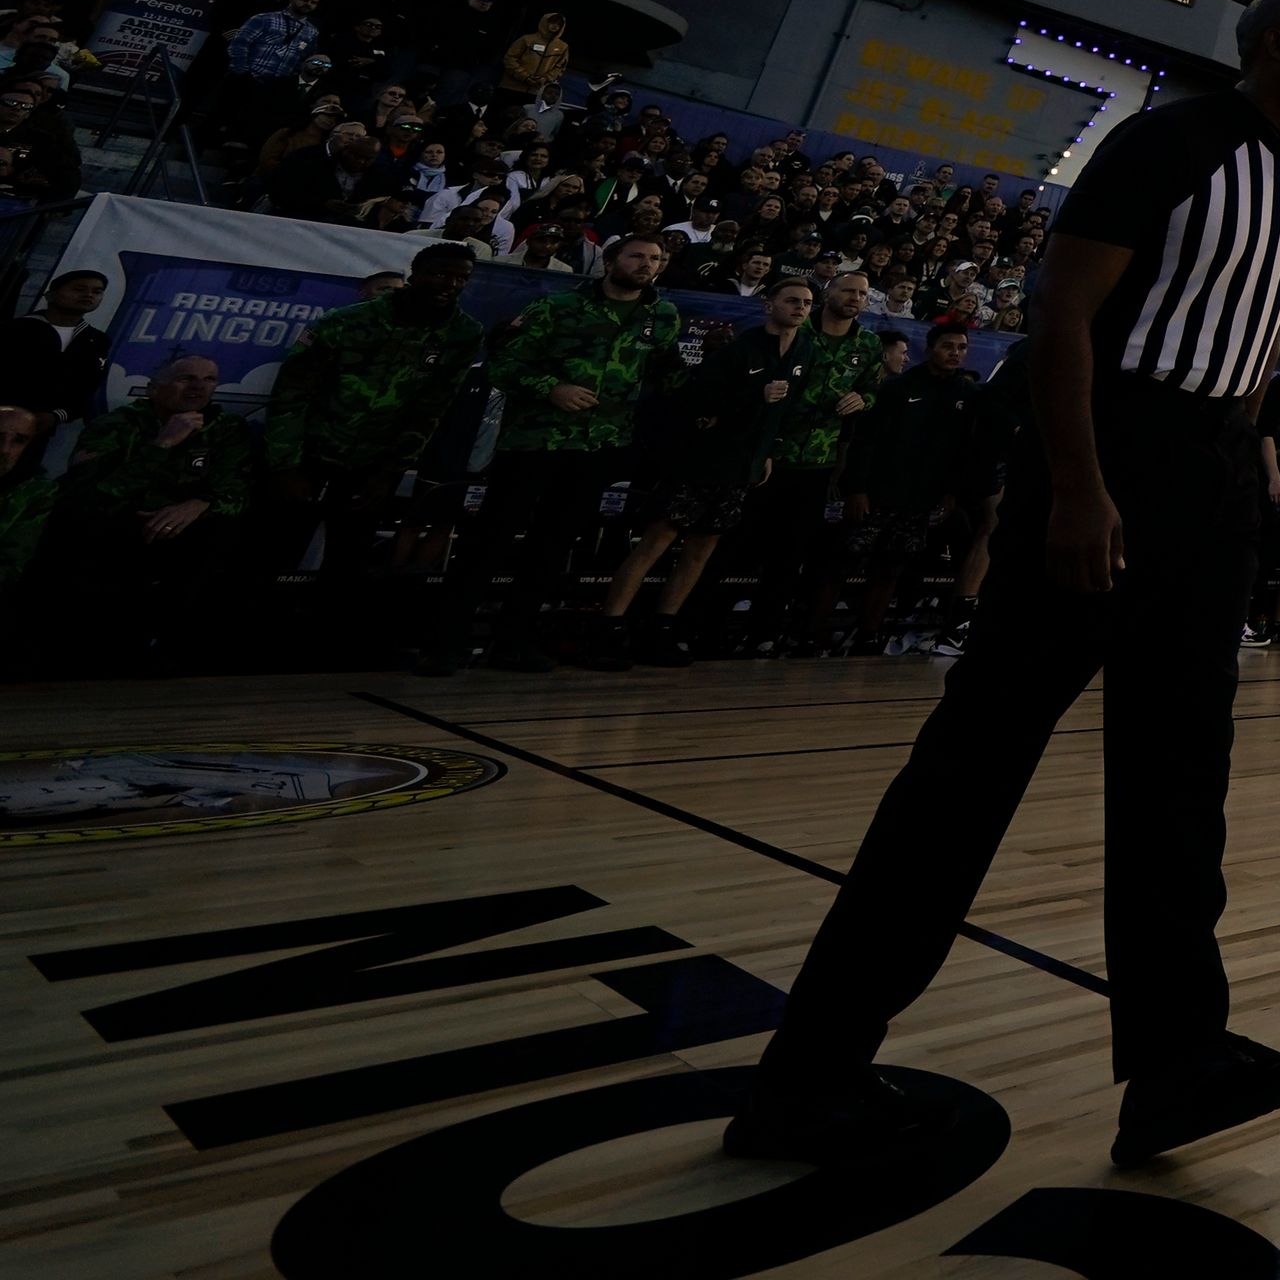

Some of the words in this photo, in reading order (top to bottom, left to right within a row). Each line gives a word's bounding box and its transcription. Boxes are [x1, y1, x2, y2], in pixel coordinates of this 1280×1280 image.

[117, 25, 191, 46] FORCES
[121, 17, 194, 38] ARMED
[98, 37, 147, 51] CARRIER
[863, 39, 992, 101] BEWARE
[1008, 84, 1045, 113] OF
[845, 78, 907, 113] JET
[920, 96, 1015, 142] BLAST
